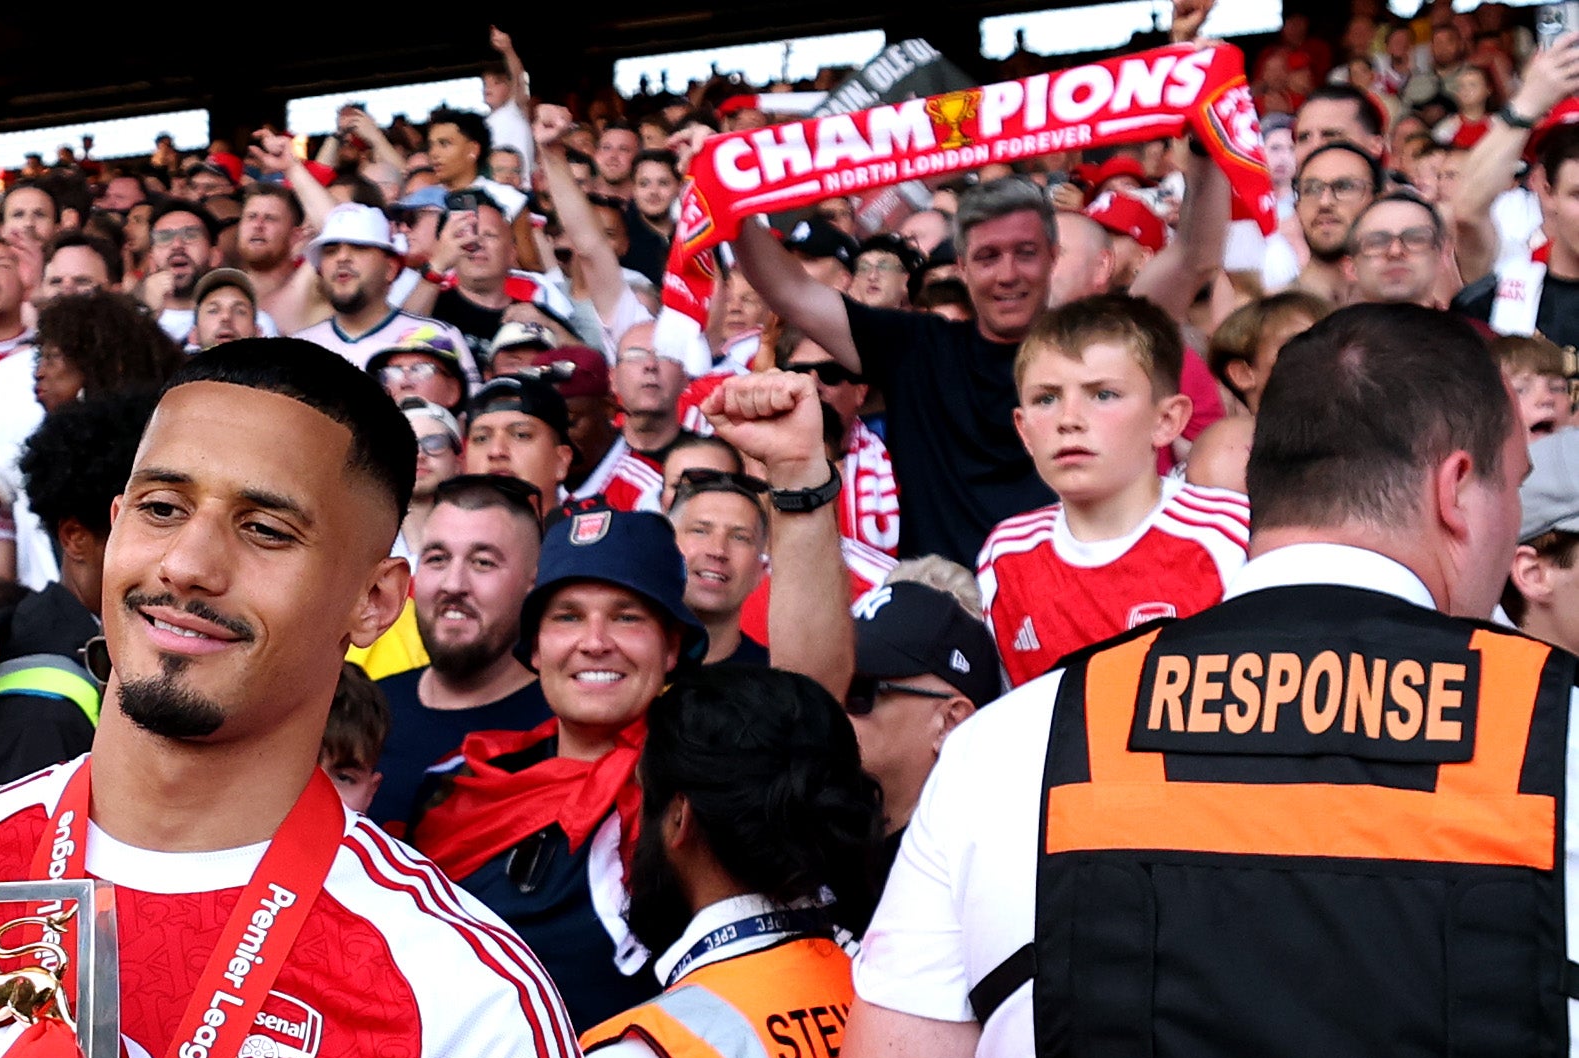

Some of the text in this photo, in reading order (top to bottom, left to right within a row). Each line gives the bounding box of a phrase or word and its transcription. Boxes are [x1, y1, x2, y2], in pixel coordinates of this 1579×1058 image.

[824, 123, 1093, 192] NORTH LONDON FOREVER
[1147, 650, 1467, 742] RESPONSE
[221, 882, 297, 992] Premier
[704, 924, 738, 950] CPFC
[254, 1011, 307, 1040] senal
